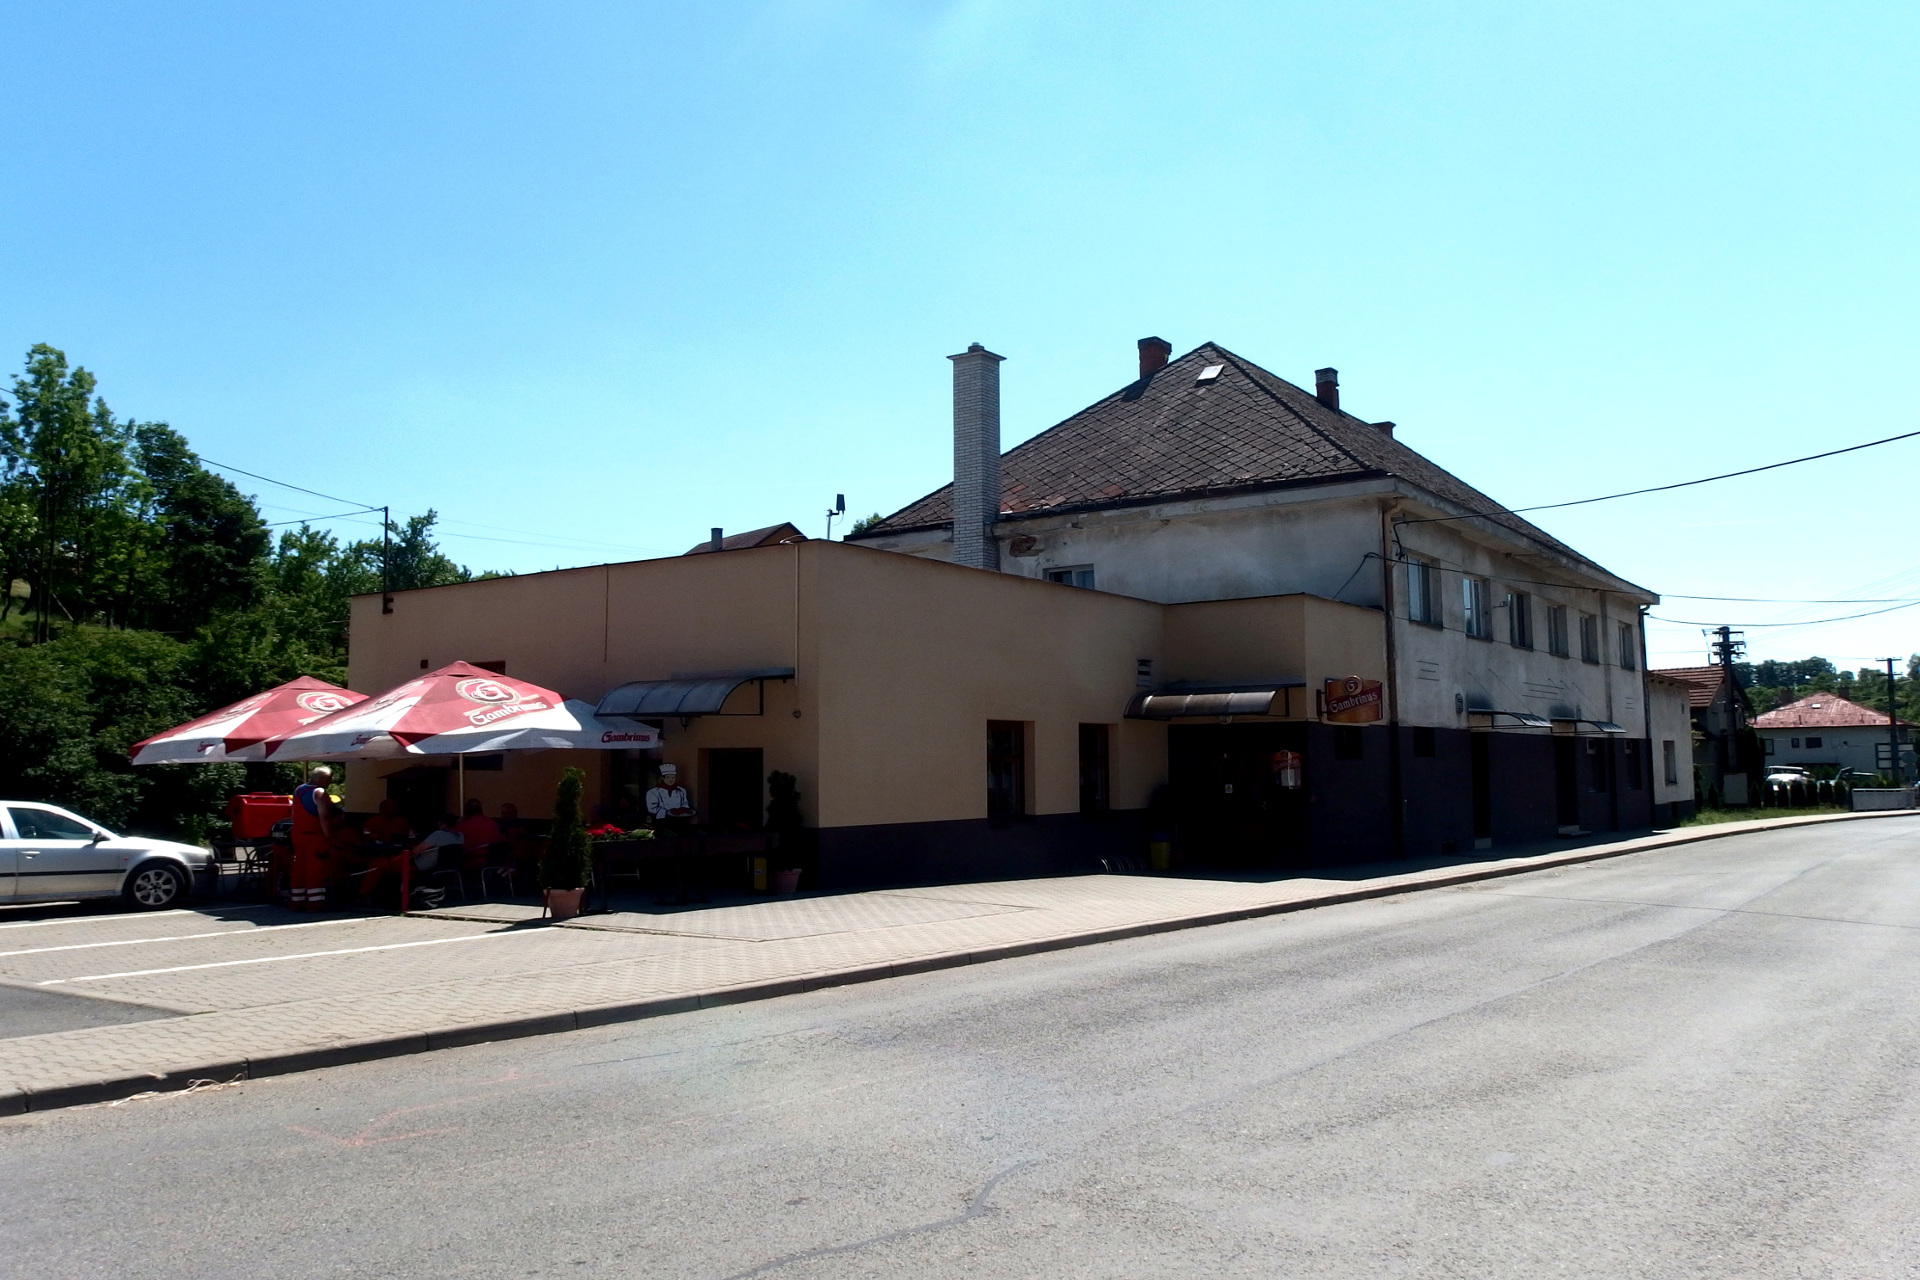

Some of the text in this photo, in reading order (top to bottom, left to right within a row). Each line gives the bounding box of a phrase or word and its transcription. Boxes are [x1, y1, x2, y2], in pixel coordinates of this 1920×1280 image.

[1329, 691, 1378, 713] Gambrinus
[469, 701, 548, 726] Gambrinus
[601, 731, 650, 743] Gambrinus
